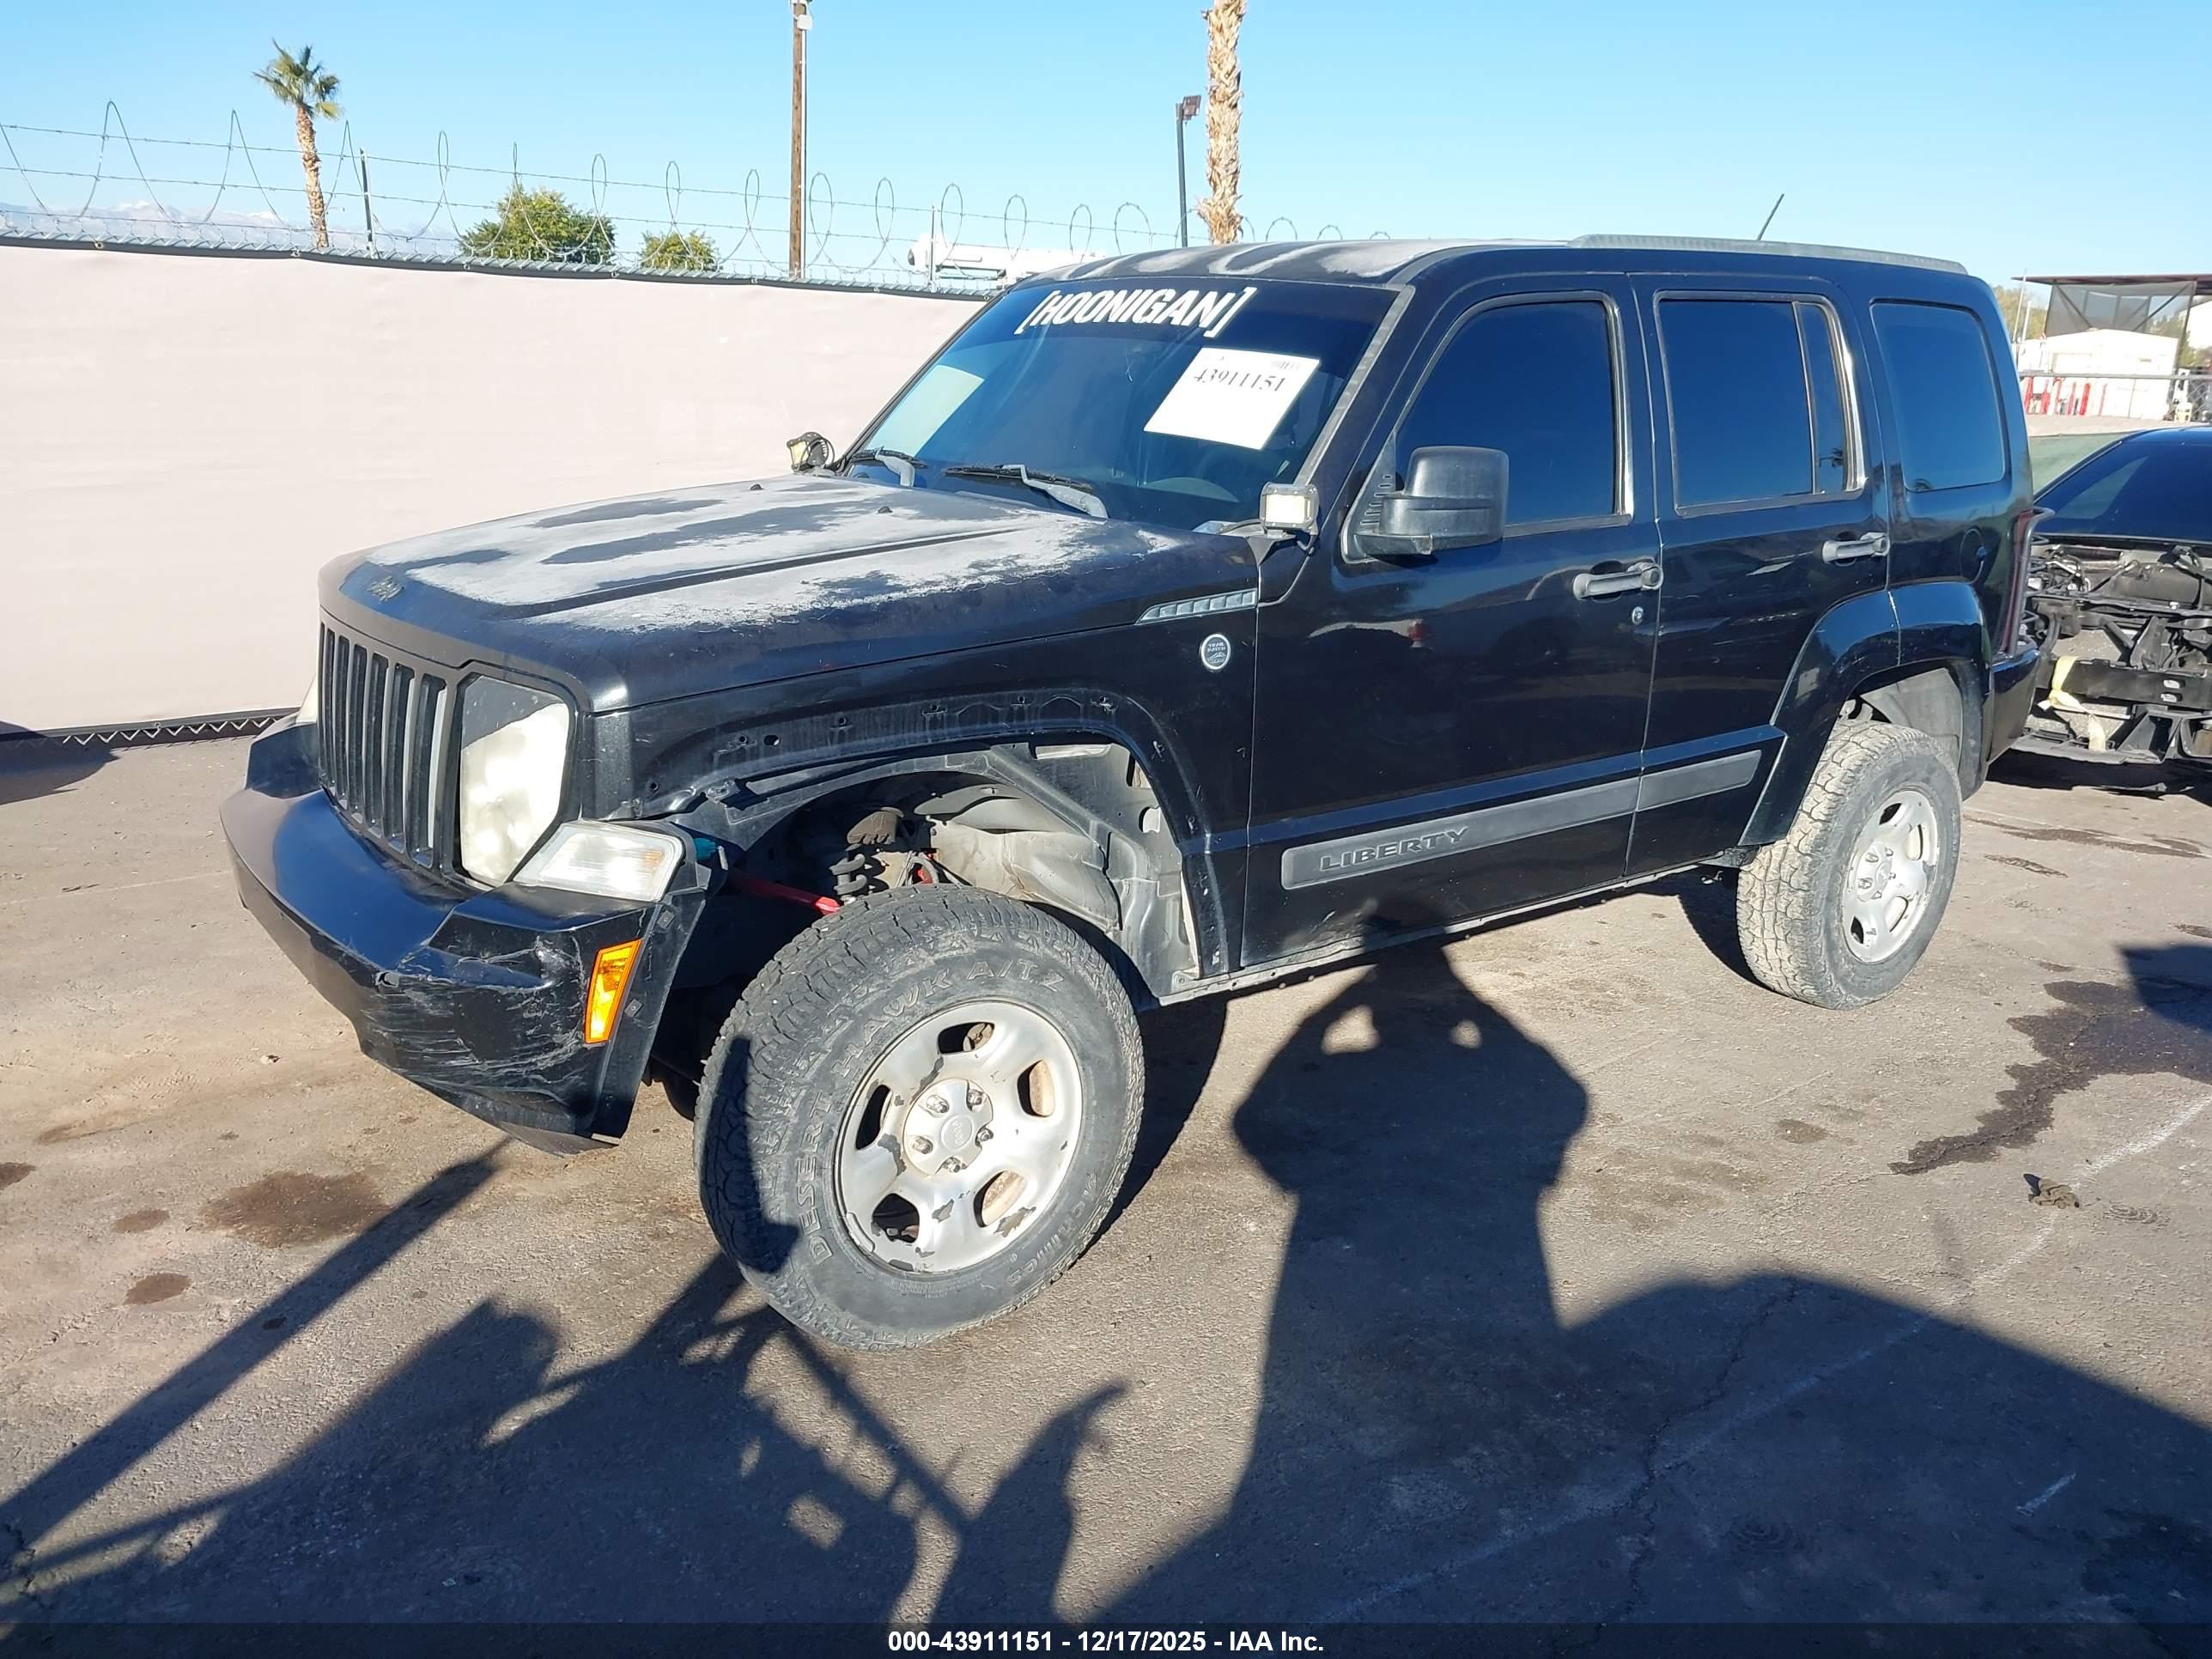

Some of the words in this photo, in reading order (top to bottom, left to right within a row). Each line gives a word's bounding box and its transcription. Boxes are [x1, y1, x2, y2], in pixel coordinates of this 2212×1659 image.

[1194, 368, 1285, 392] 43911151
[1320, 826, 1469, 872] LIBERTY
[797, 1091, 833, 1265] DESERT
[830, 968, 953, 1079] HAWK
